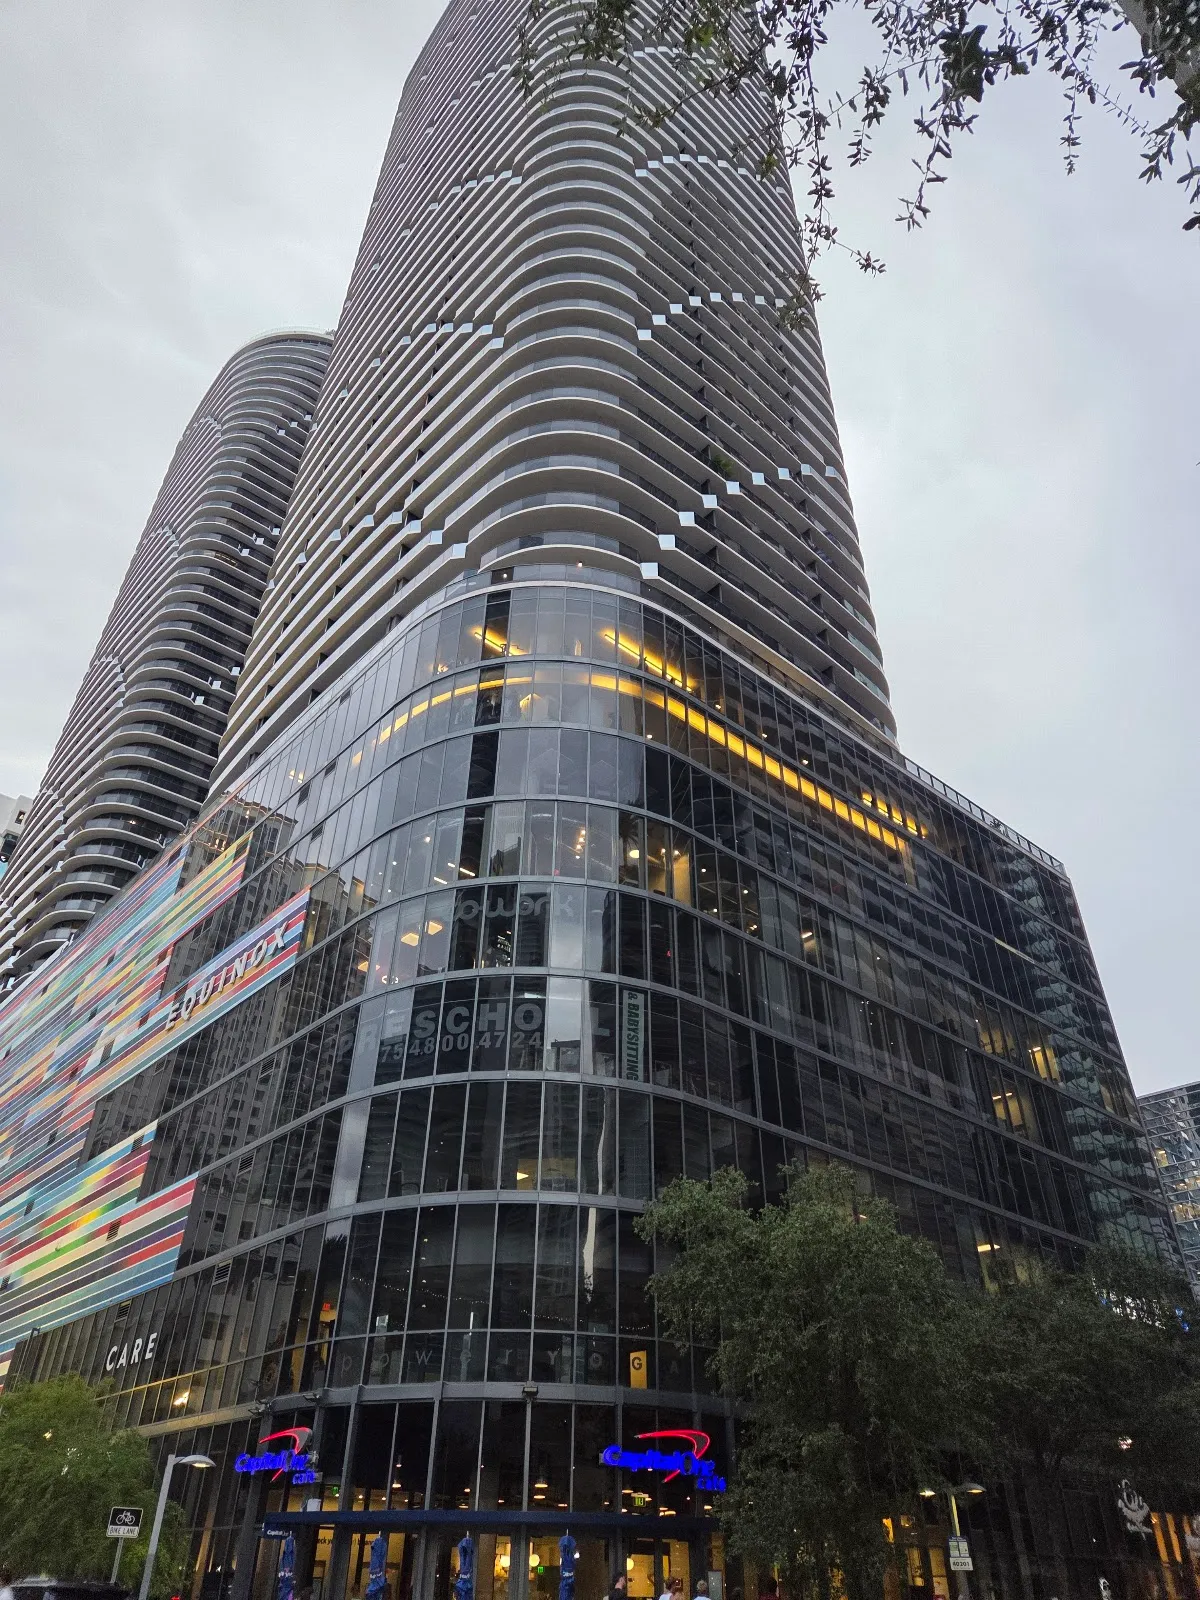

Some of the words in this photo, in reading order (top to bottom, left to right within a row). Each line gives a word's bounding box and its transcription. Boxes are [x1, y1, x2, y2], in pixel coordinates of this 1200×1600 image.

[165, 920, 290, 1031] EQUINOX
[336, 1003, 610, 1064] PRESCHOL
[626, 1003, 640, 1081] BABYSITTING
[106, 1332, 158, 1371] CARE
[109, 1526, 121, 1535] BIKE
[122, 1527, 137, 1536] LANE
